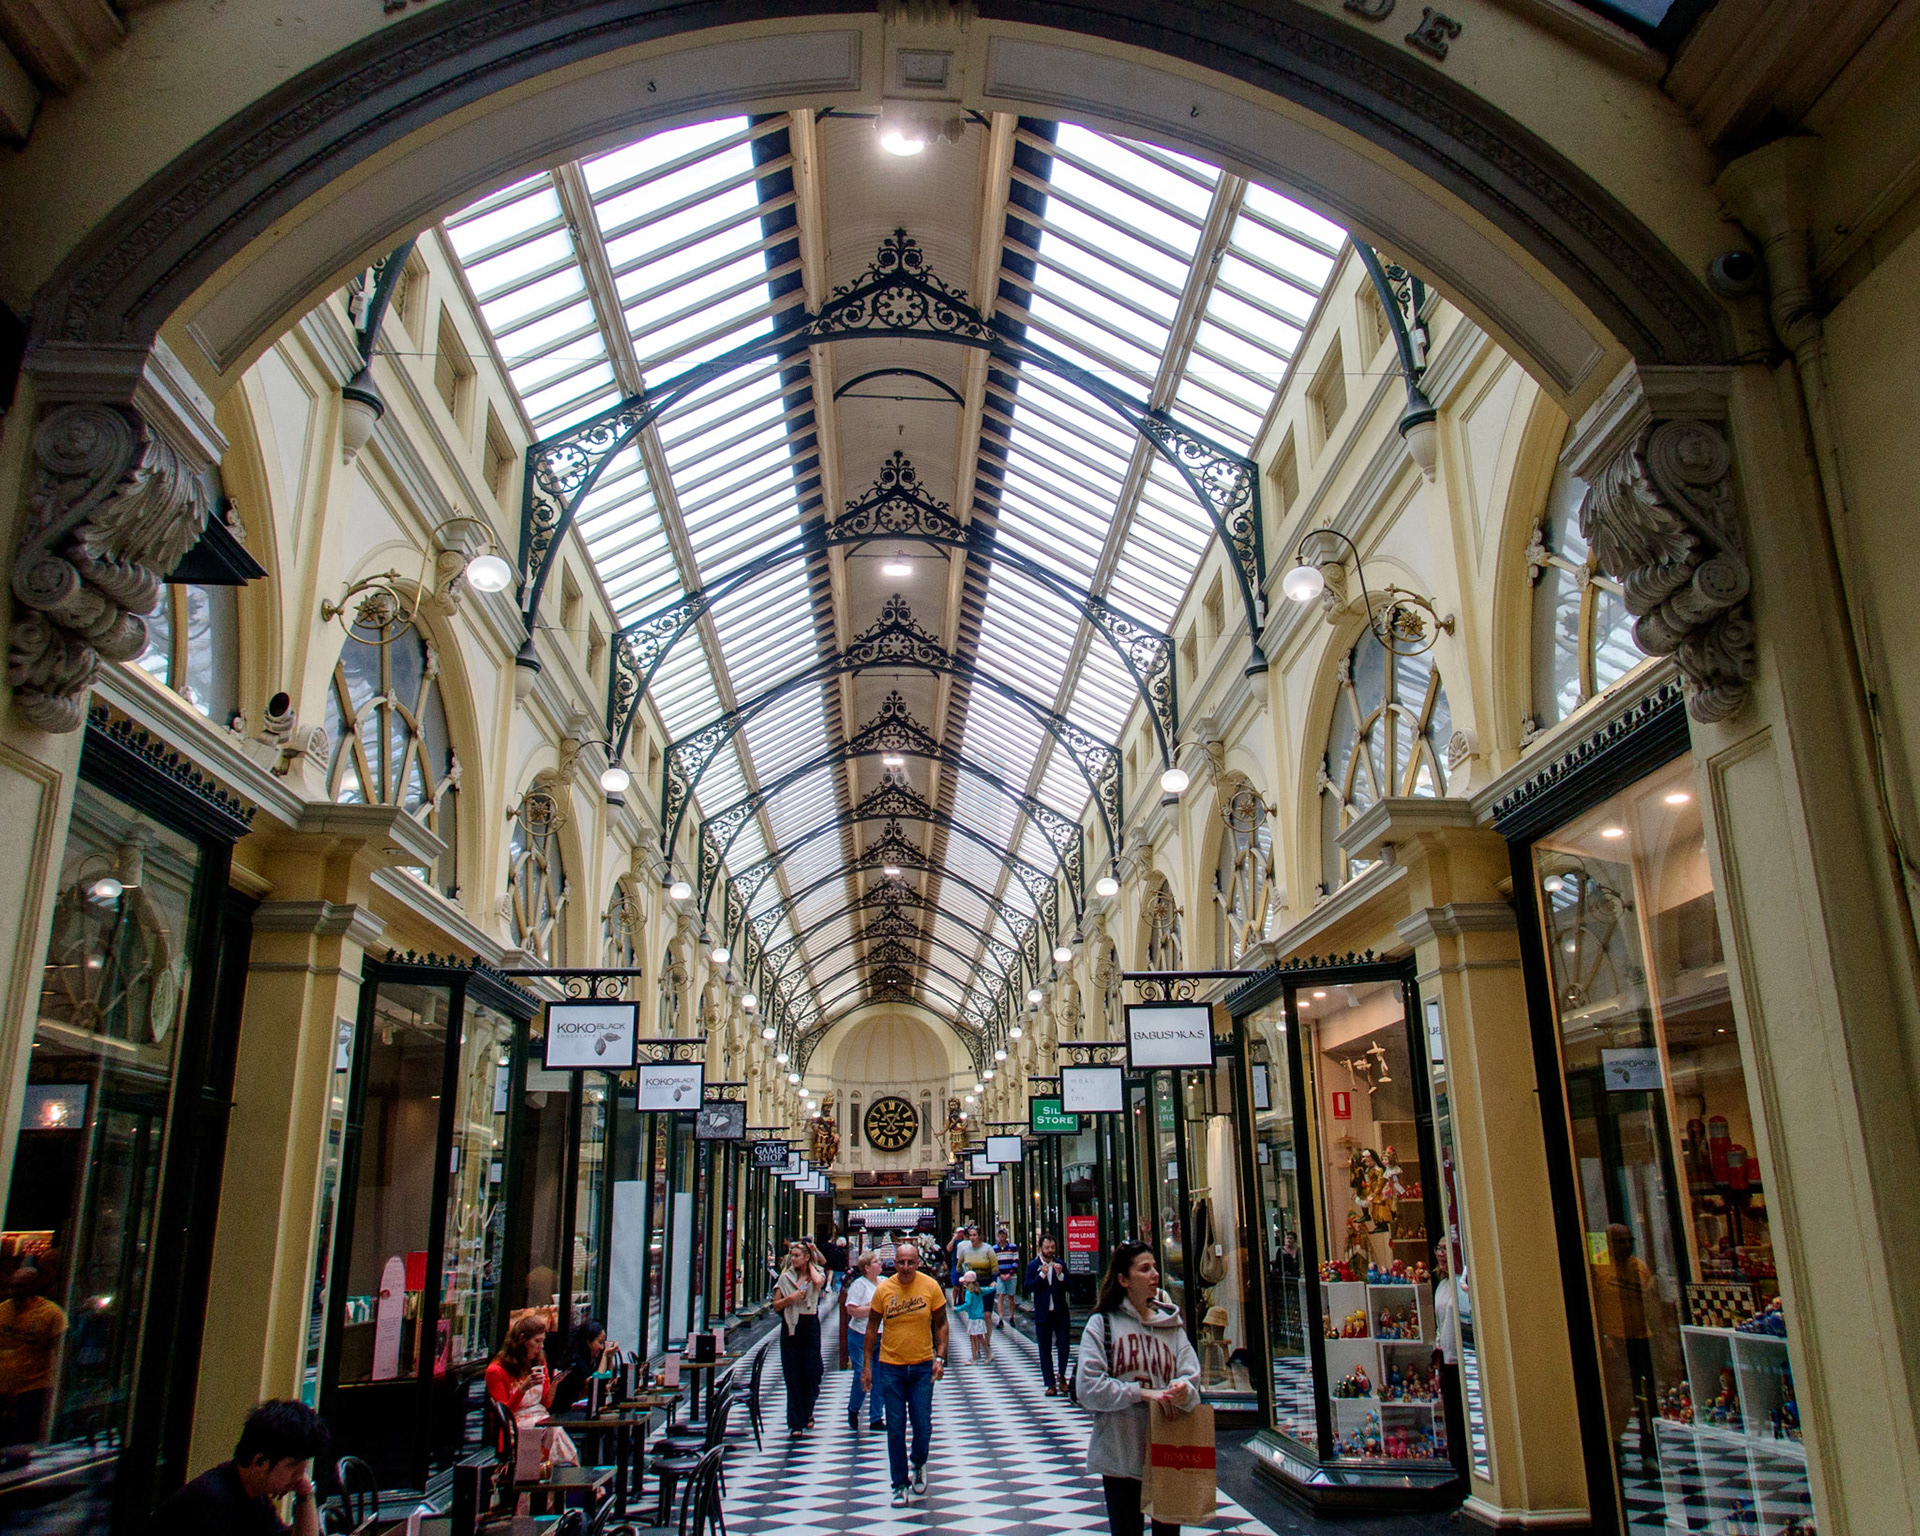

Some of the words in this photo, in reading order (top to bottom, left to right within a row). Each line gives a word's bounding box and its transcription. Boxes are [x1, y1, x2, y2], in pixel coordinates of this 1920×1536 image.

[557, 1023, 596, 1034] KOKO
[1133, 1030, 1205, 1040] BABUSHKAS
[646, 1078, 674, 1086] KOKO
[1043, 1106, 1060, 1114] SIL
[1037, 1116, 1073, 1124] STORE
[754, 1146, 787, 1154] GAMES
